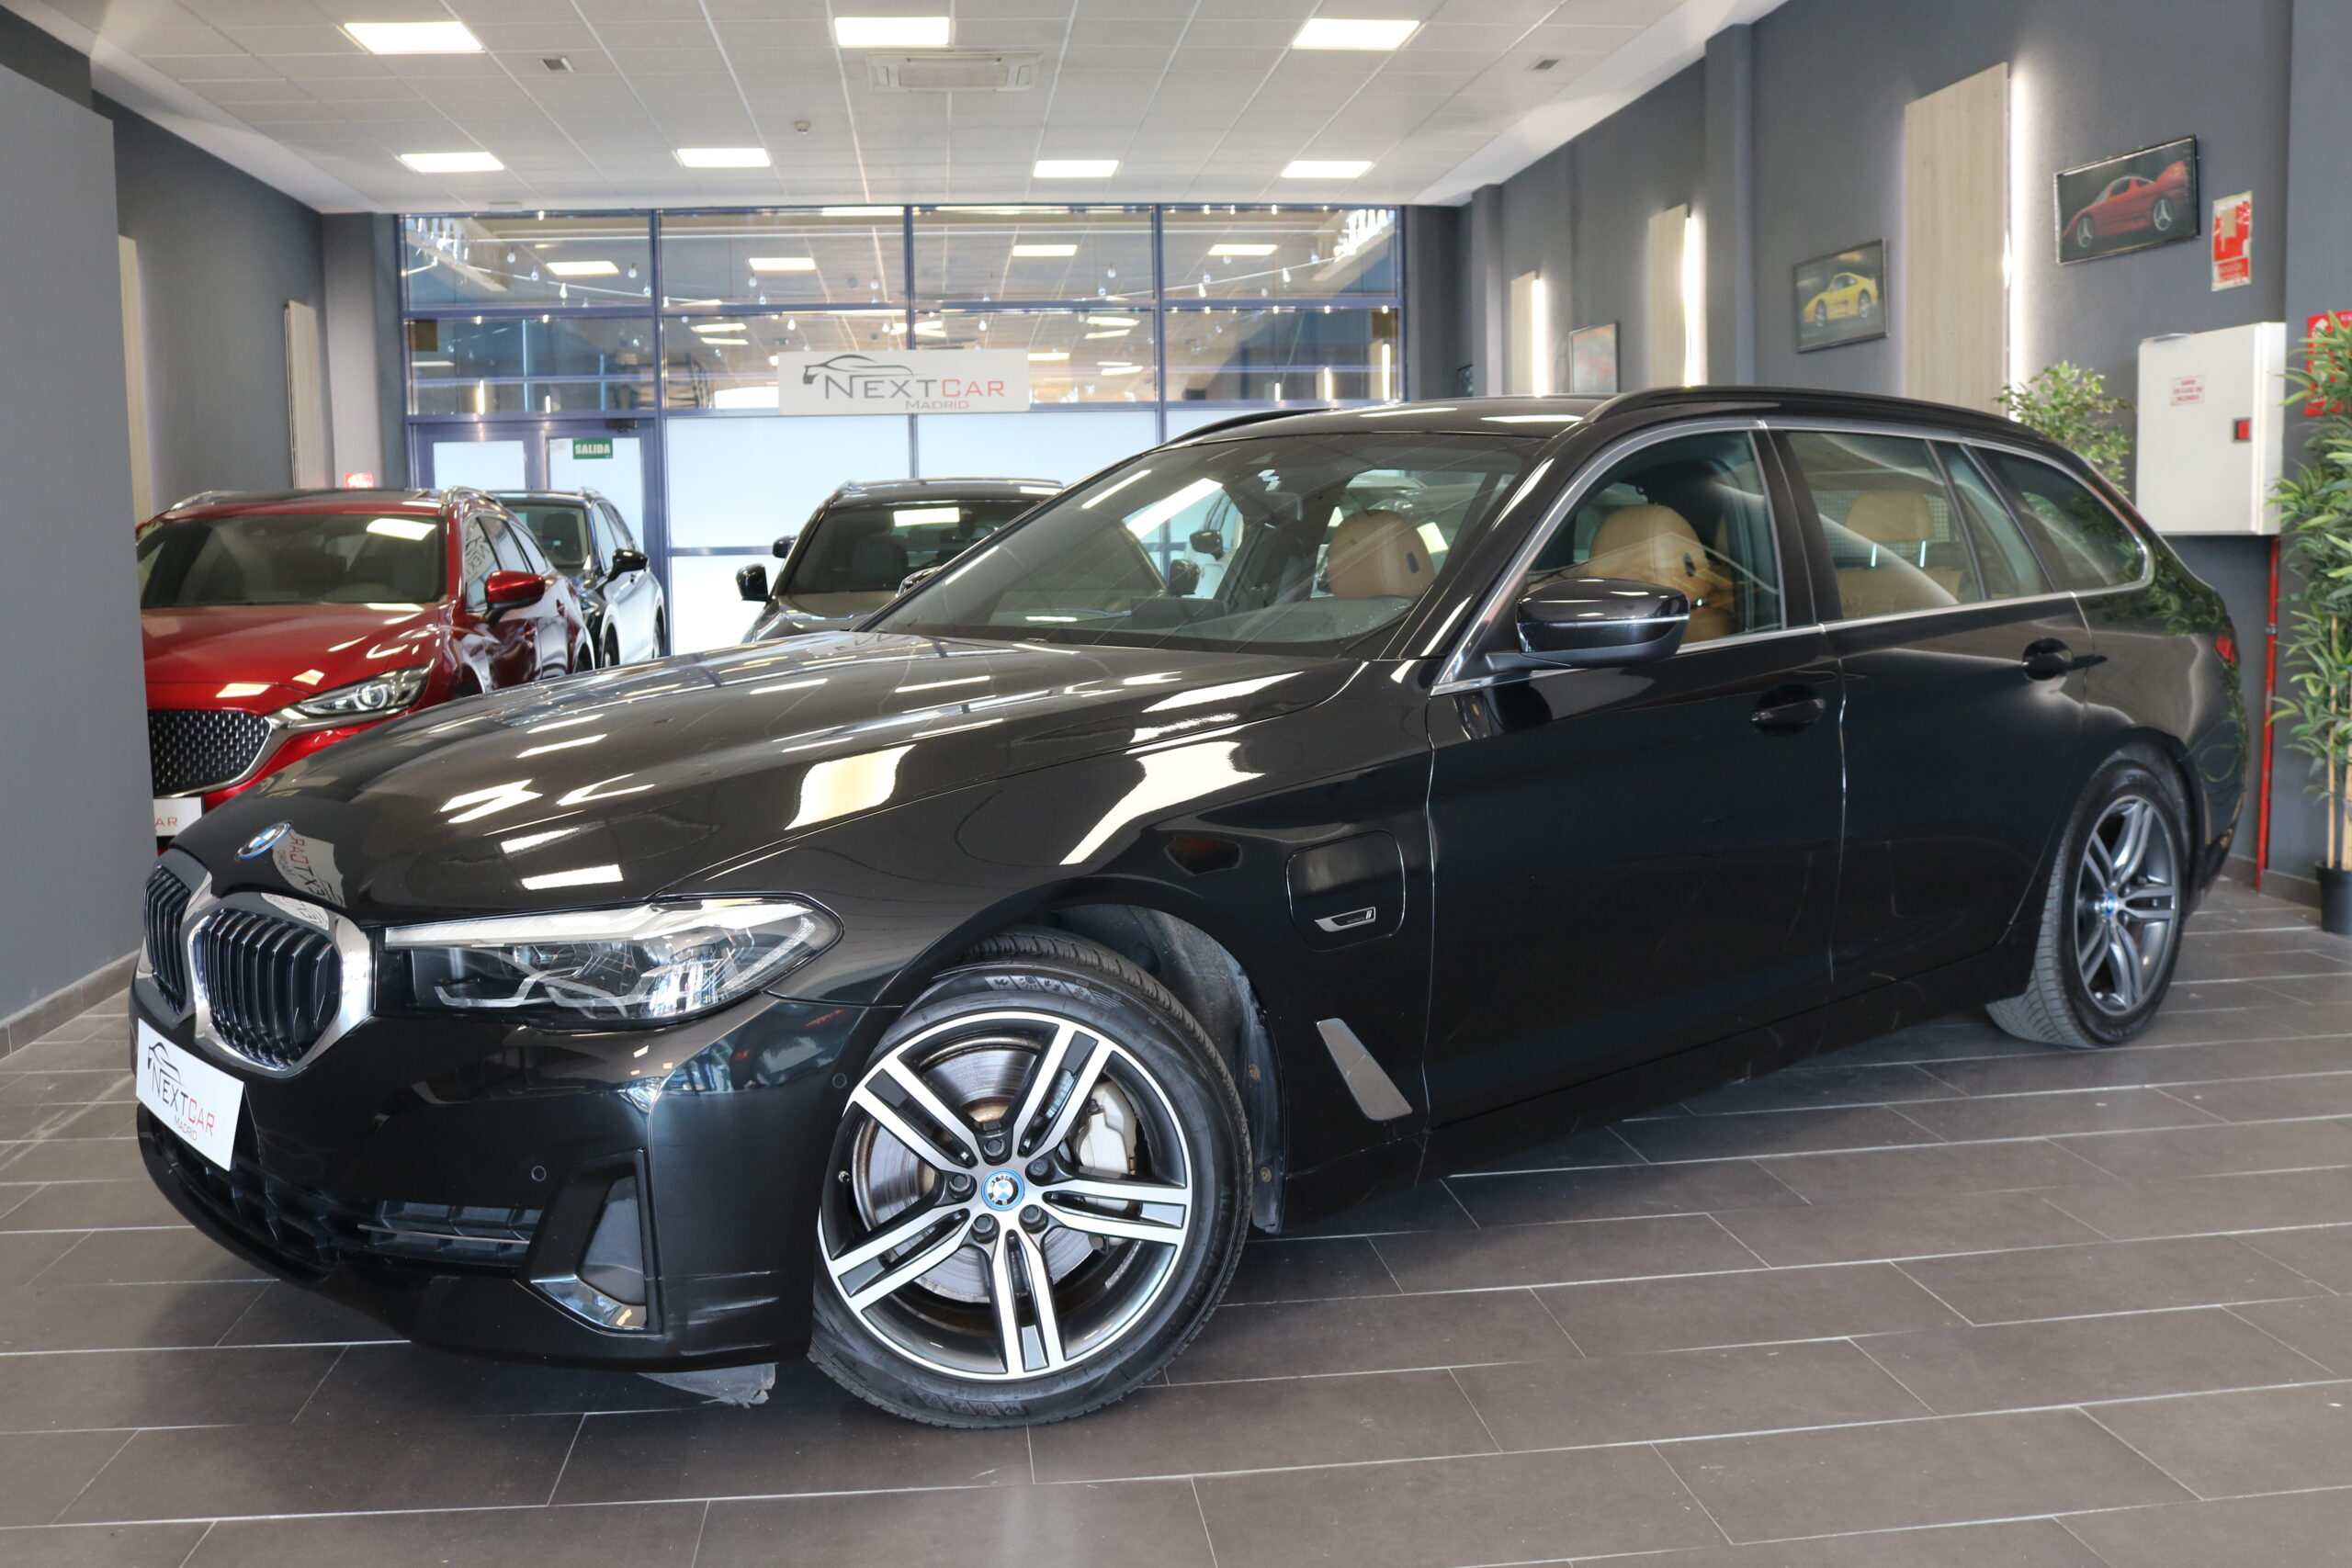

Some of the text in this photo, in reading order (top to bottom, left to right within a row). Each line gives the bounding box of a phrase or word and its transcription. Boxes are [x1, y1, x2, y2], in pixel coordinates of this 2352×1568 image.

[906, 400, 969, 410] MADRID
[574, 444, 611, 455] SALIDA
[175, 1115, 198, 1141] MADRID
